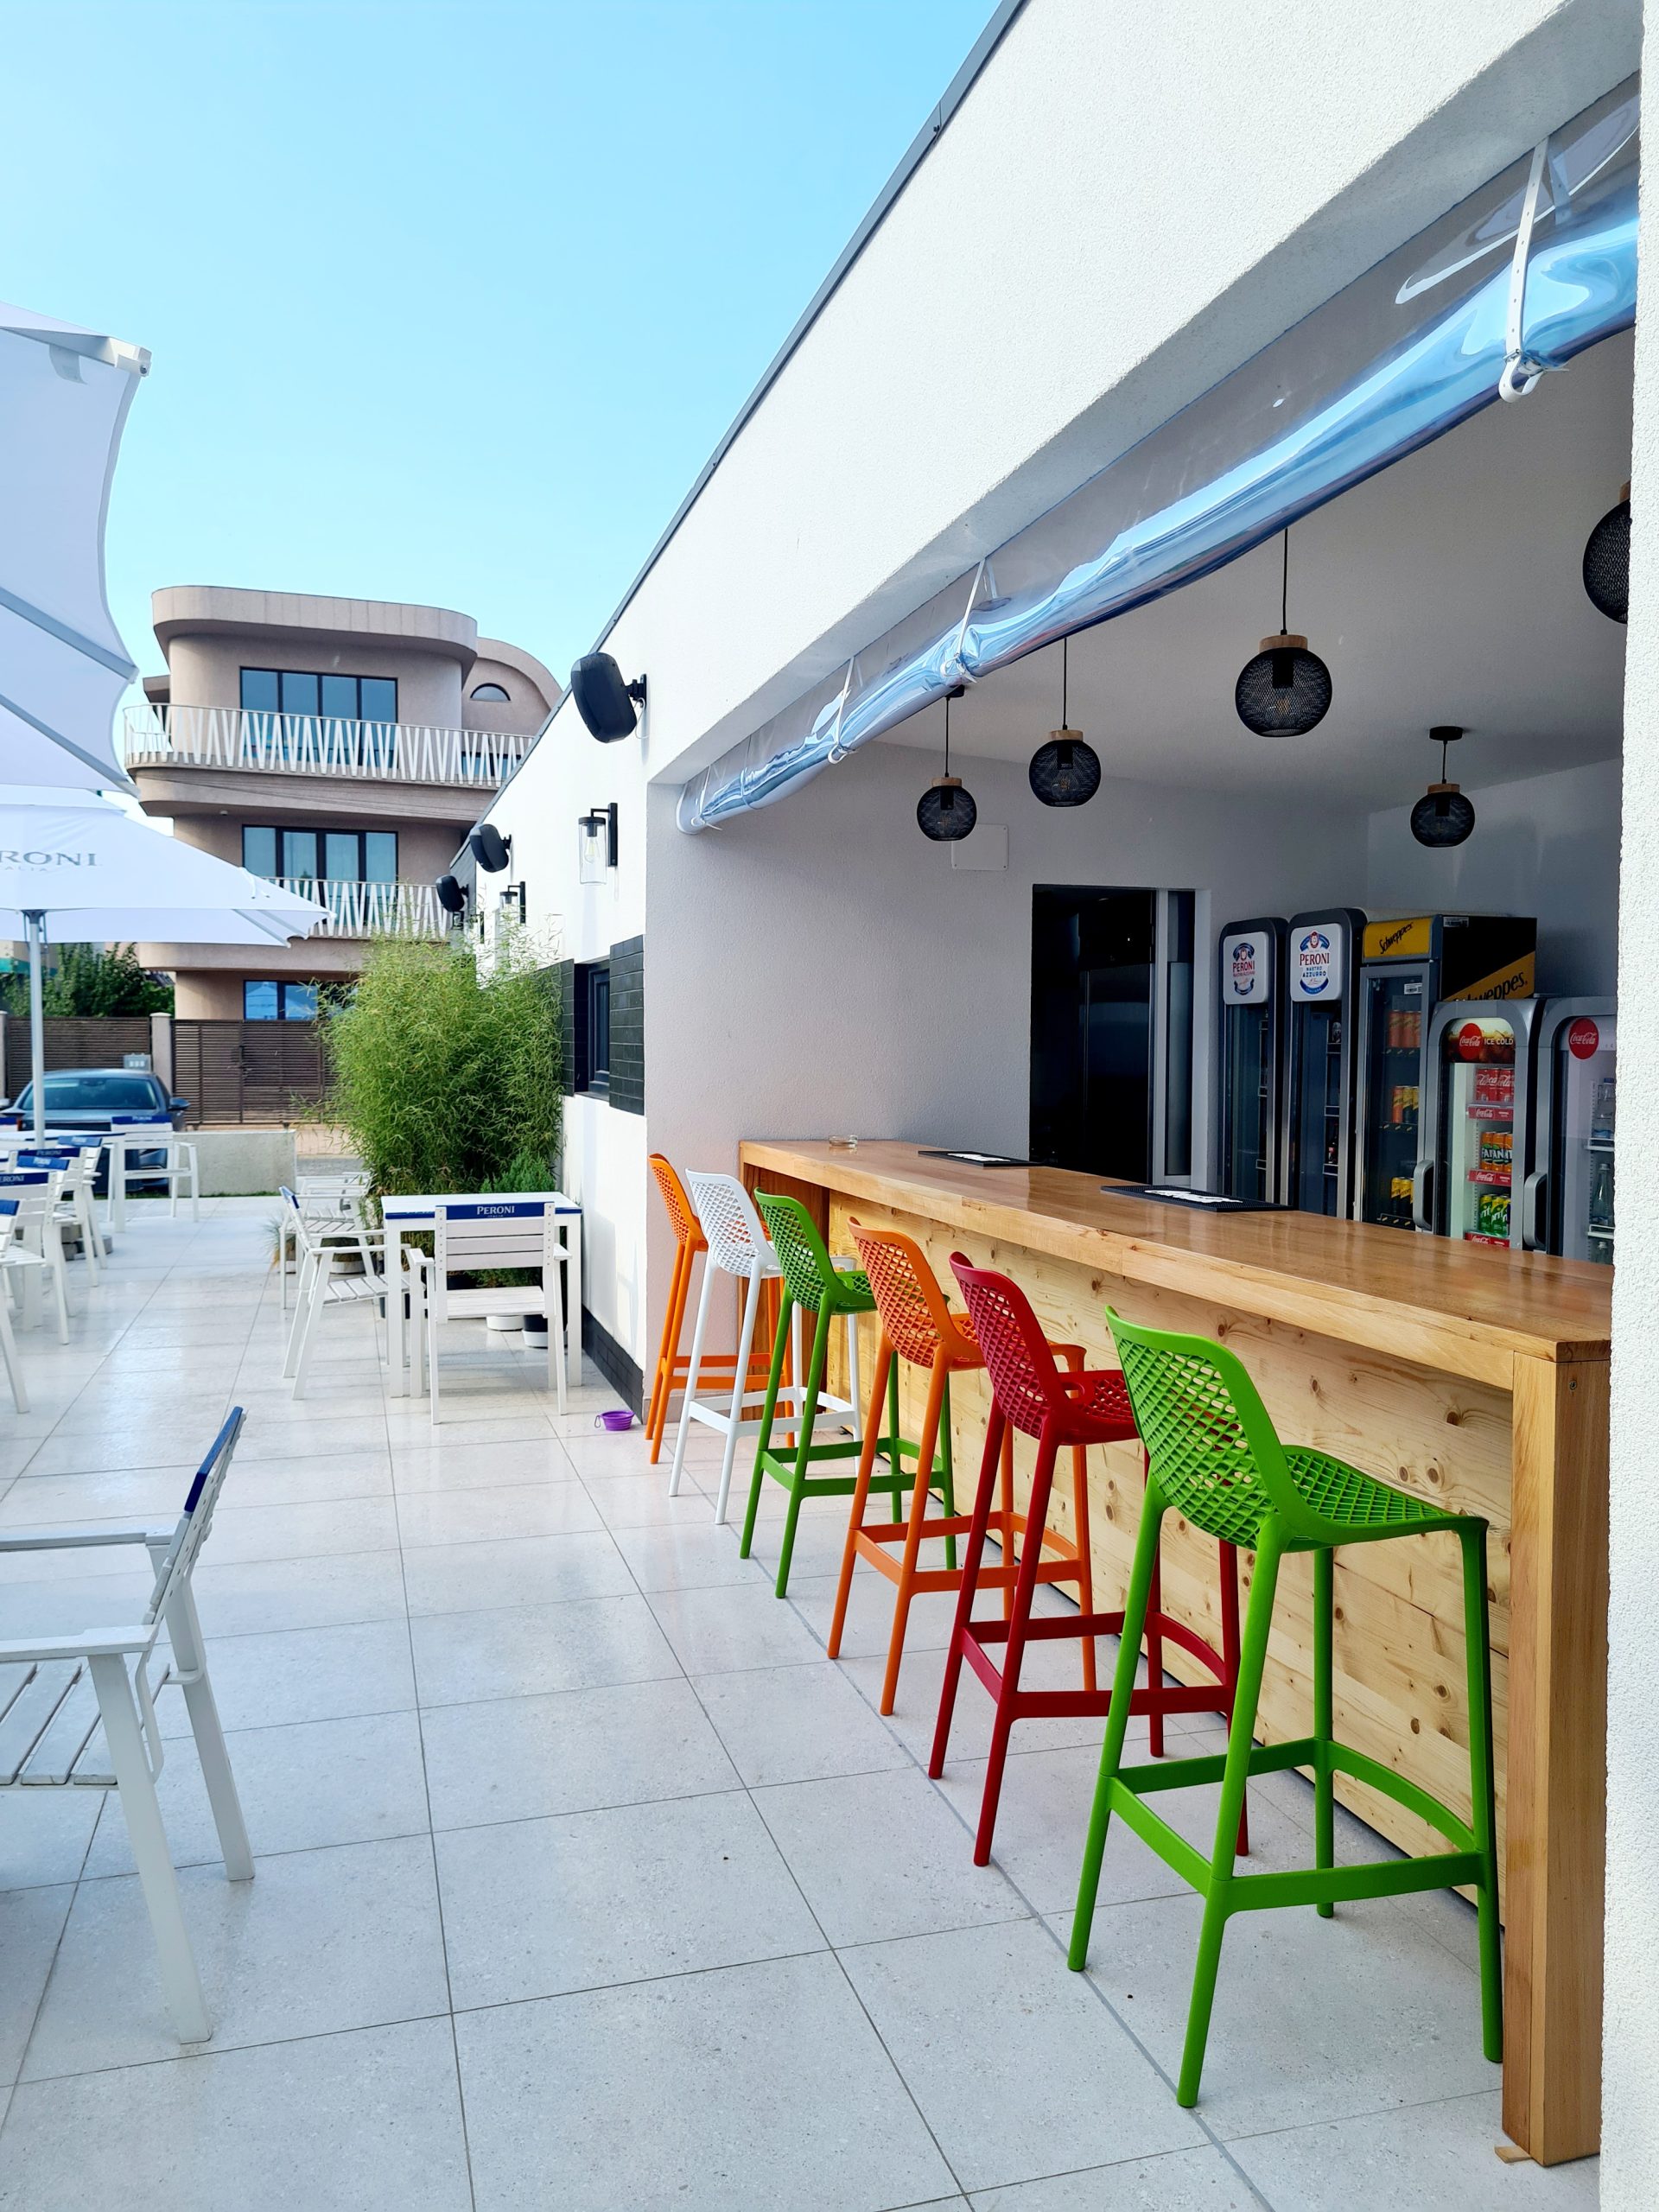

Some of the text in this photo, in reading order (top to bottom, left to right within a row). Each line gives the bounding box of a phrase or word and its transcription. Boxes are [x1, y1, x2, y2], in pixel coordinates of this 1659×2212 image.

[1378, 921, 1414, 955] Schweppes
[1299, 952, 1330, 966] PERONI
[1232, 960, 1255, 973] PERONI
[1570, 1032, 1598, 1045] Coca-Cola
[476, 1205, 516, 1215] PERONI
